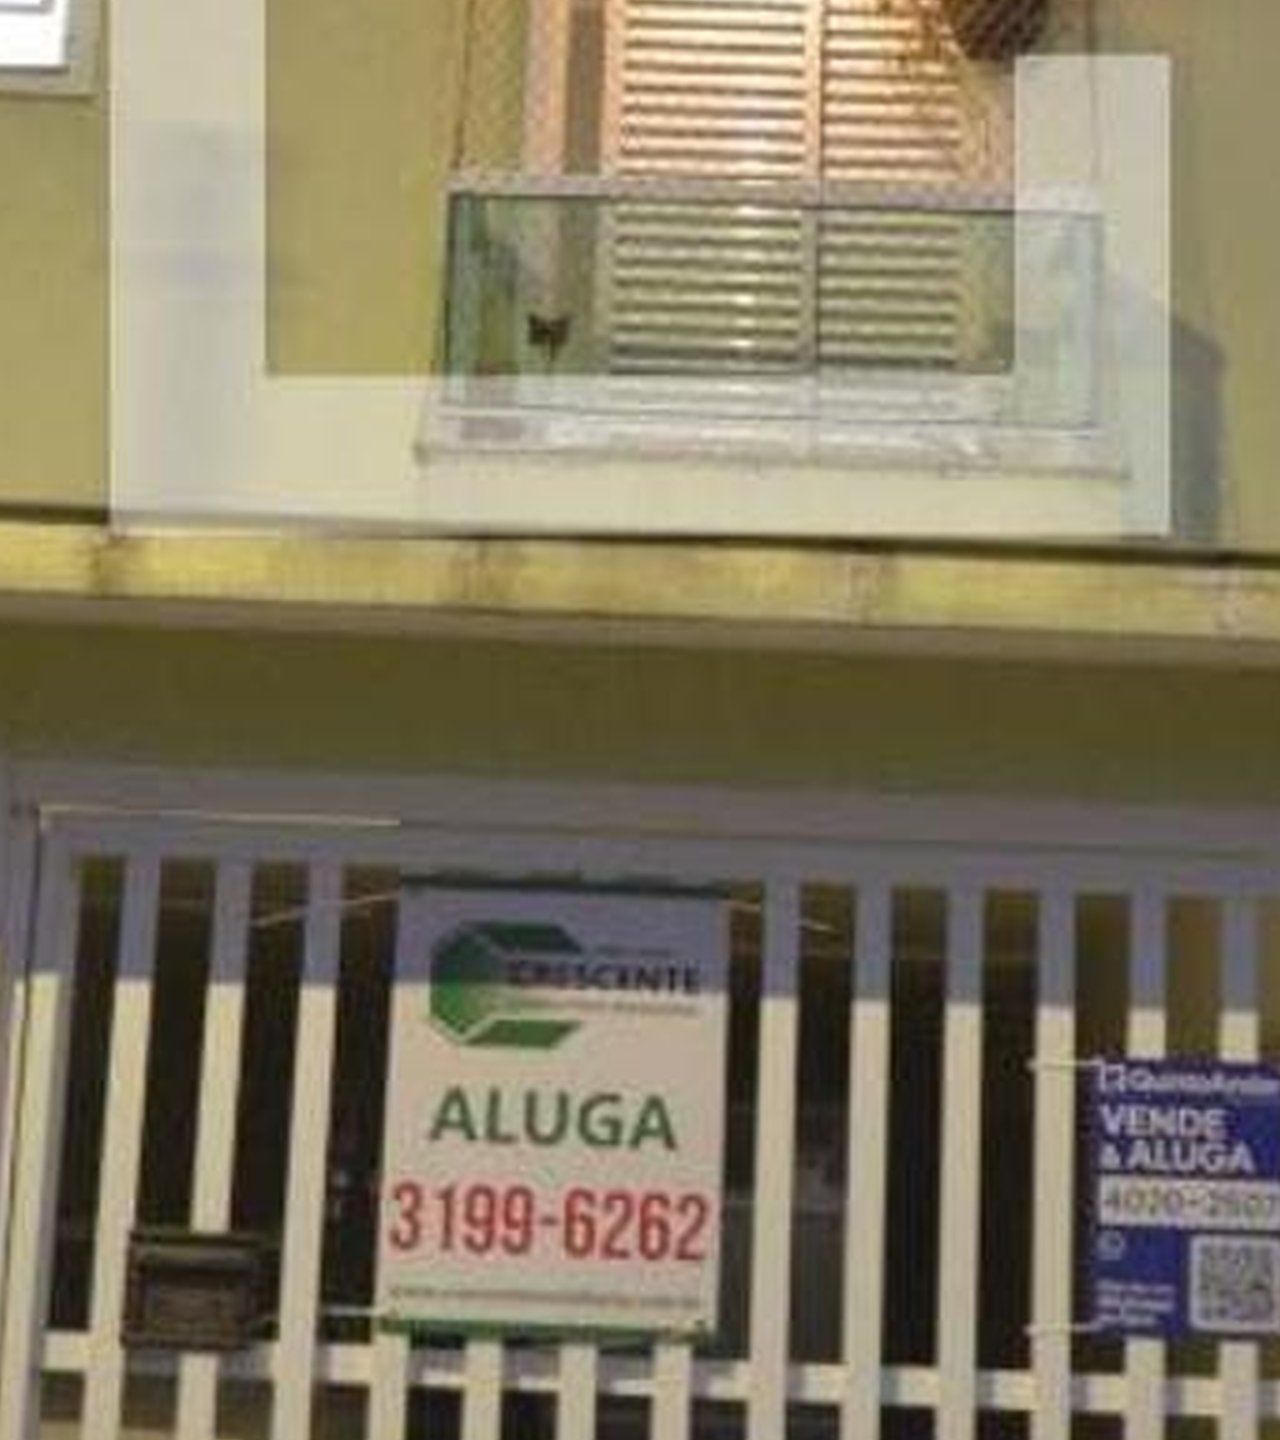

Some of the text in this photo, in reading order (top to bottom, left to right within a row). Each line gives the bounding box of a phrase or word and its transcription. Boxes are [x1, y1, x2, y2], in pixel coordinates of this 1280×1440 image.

[428, 1084, 678, 1152] ALUGA
[1099, 1103, 1226, 1138] VENDE
[1127, 1139, 1256, 1172] ALUGA
[389, 1180, 709, 1261] 3199-6262
